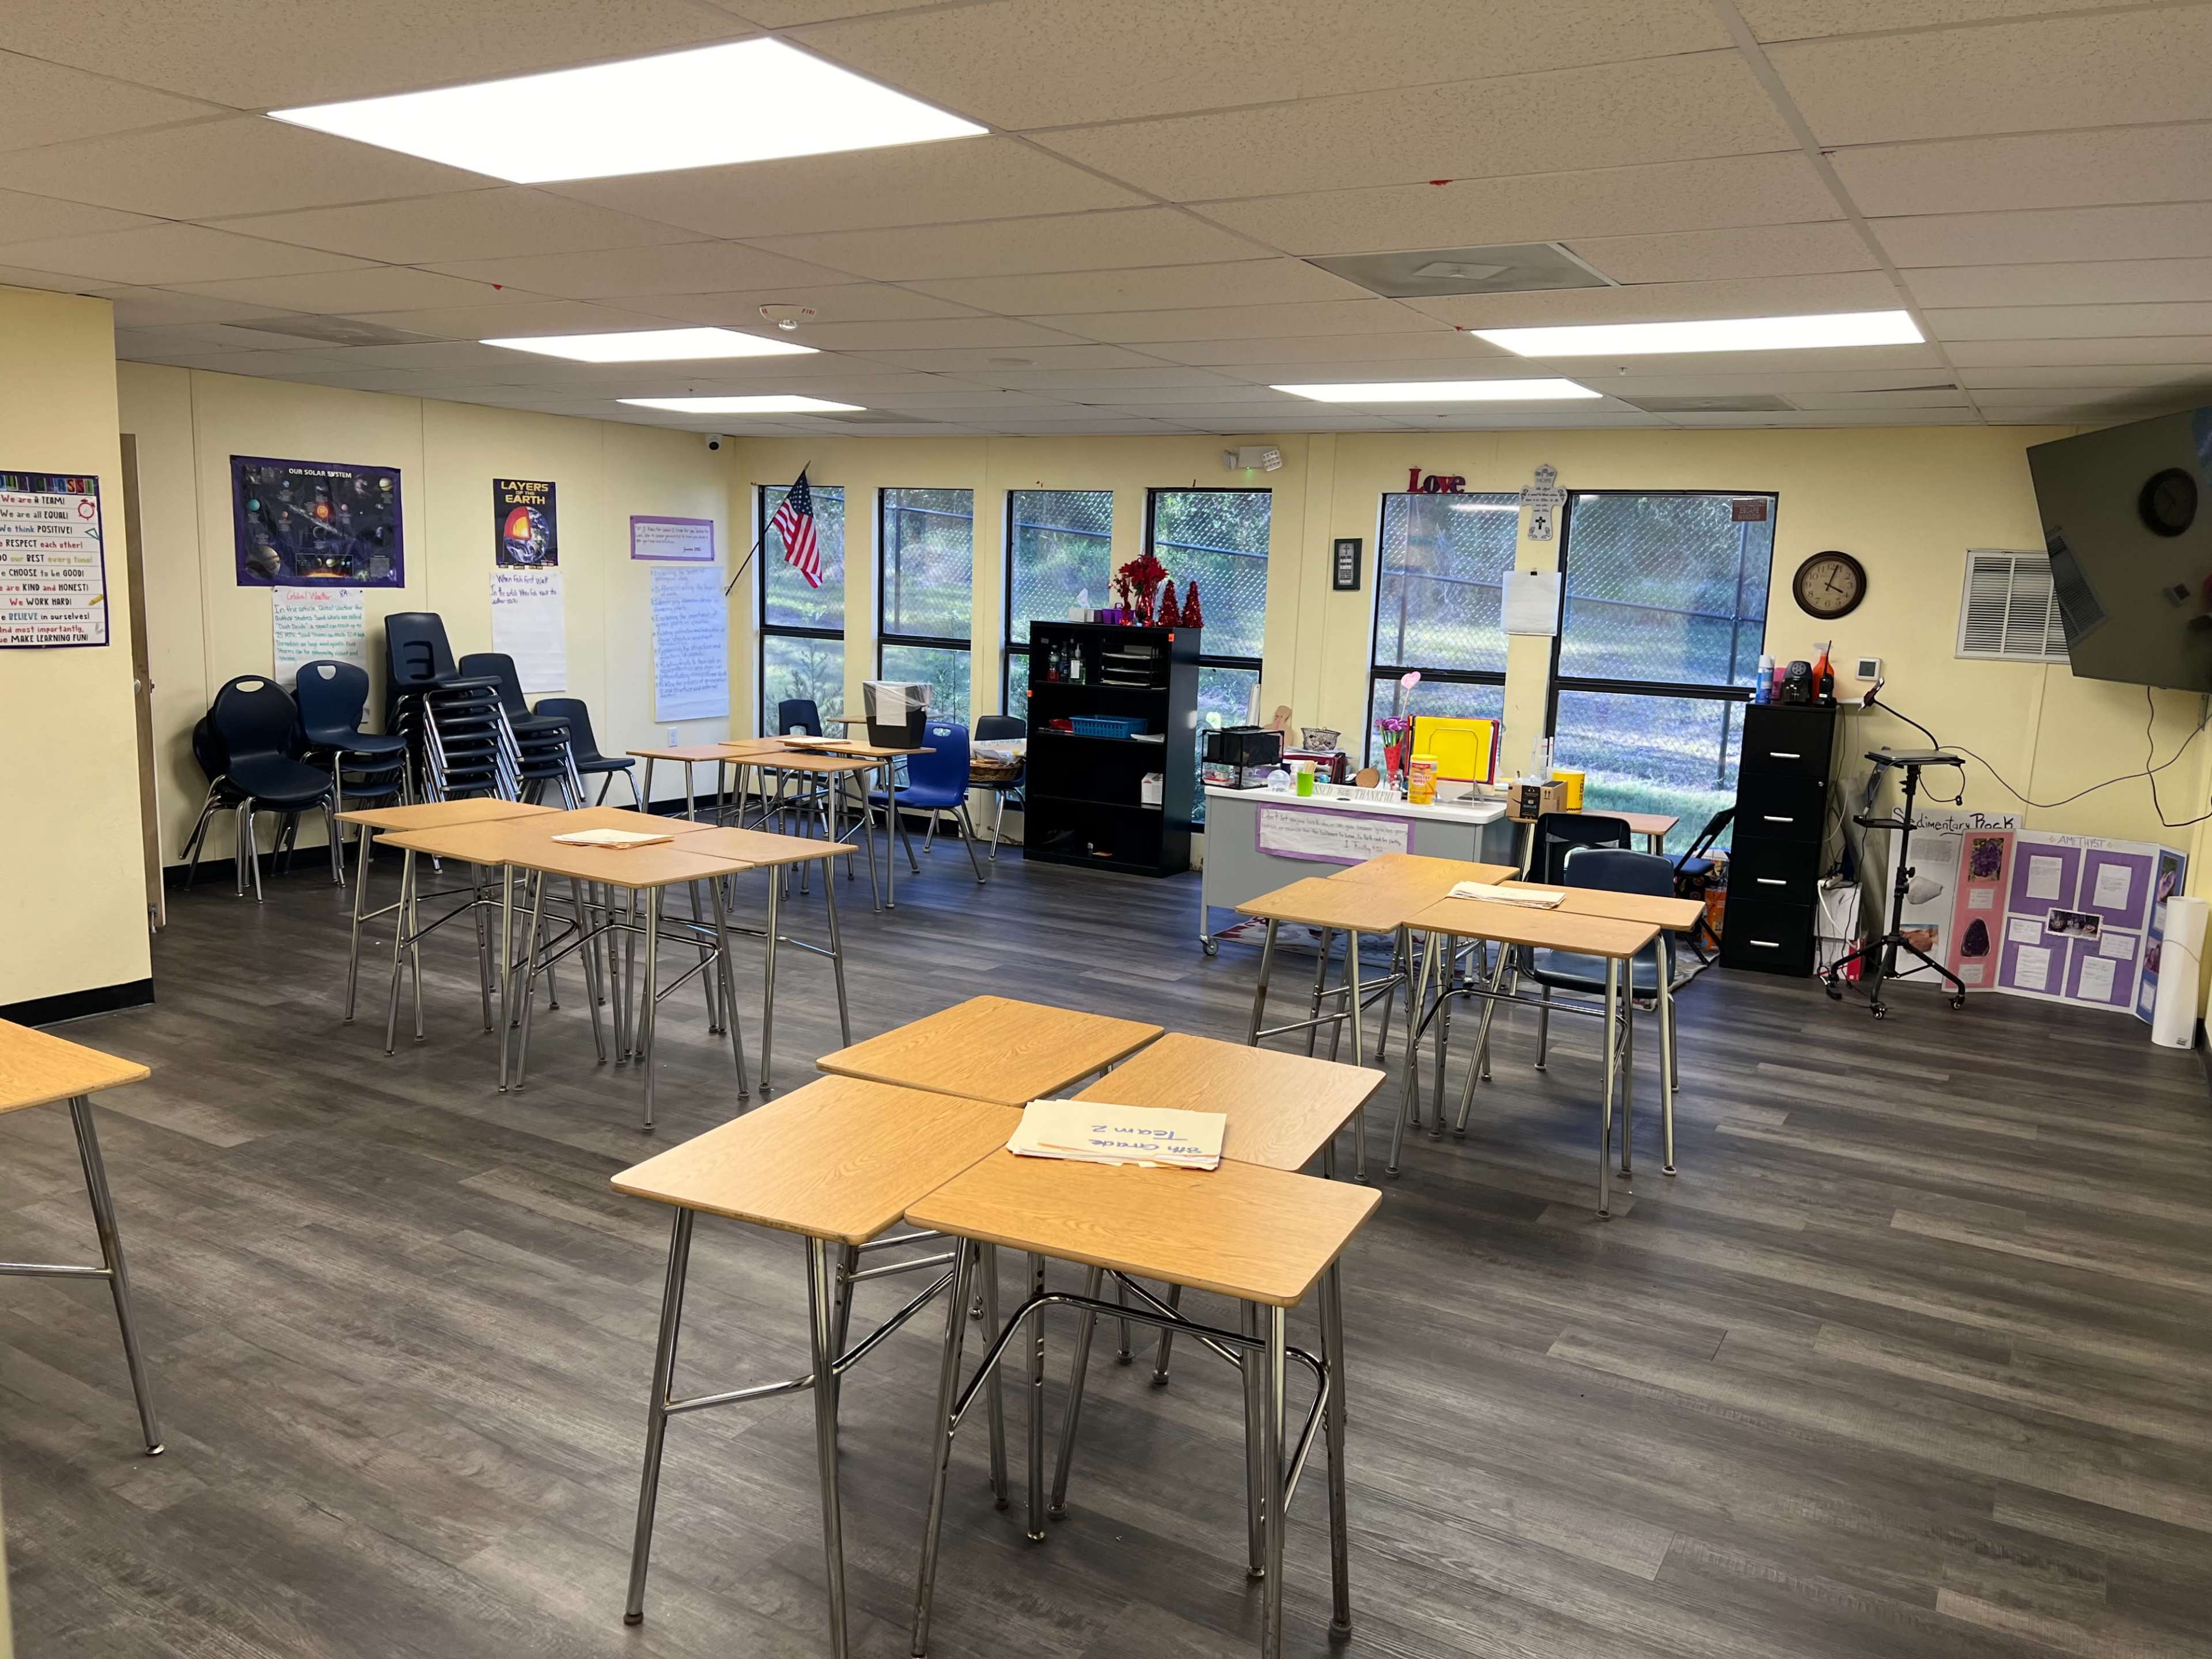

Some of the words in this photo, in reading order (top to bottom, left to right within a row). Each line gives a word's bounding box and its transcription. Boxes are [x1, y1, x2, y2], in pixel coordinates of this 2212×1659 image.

[327, 471, 352, 479] SYSTEM
[1407, 468, 1465, 494] Love
[501, 481, 548, 492] LAYERS
[1, 494, 15, 503] We
[35, 496, 39, 504] A
[42, 497, 65, 505] TEAM!
[505, 495, 546, 505] EARTH
[0, 509, 13, 517] We
[44, 511, 68, 520] EQUAL!
[37, 525, 72, 534] POSITIVE!
[6, 539, 37, 547] RESPECT
[63, 569, 84, 577] GOOD!
[1845, 571, 1850, 579] 2
[59, 584, 88, 592] HONEST!
[1836, 598, 1842, 607] 5
[286, 605, 297, 613] the
[37, 624, 84, 634] importantly,
[11, 635, 34, 643] MAKE
[37, 634, 70, 642] LEARNING
[2057, 835, 2106, 849] AMETHYST
[1114, 1125, 1188, 1141] Team
[1089, 1139, 1160, 1150] Grade
